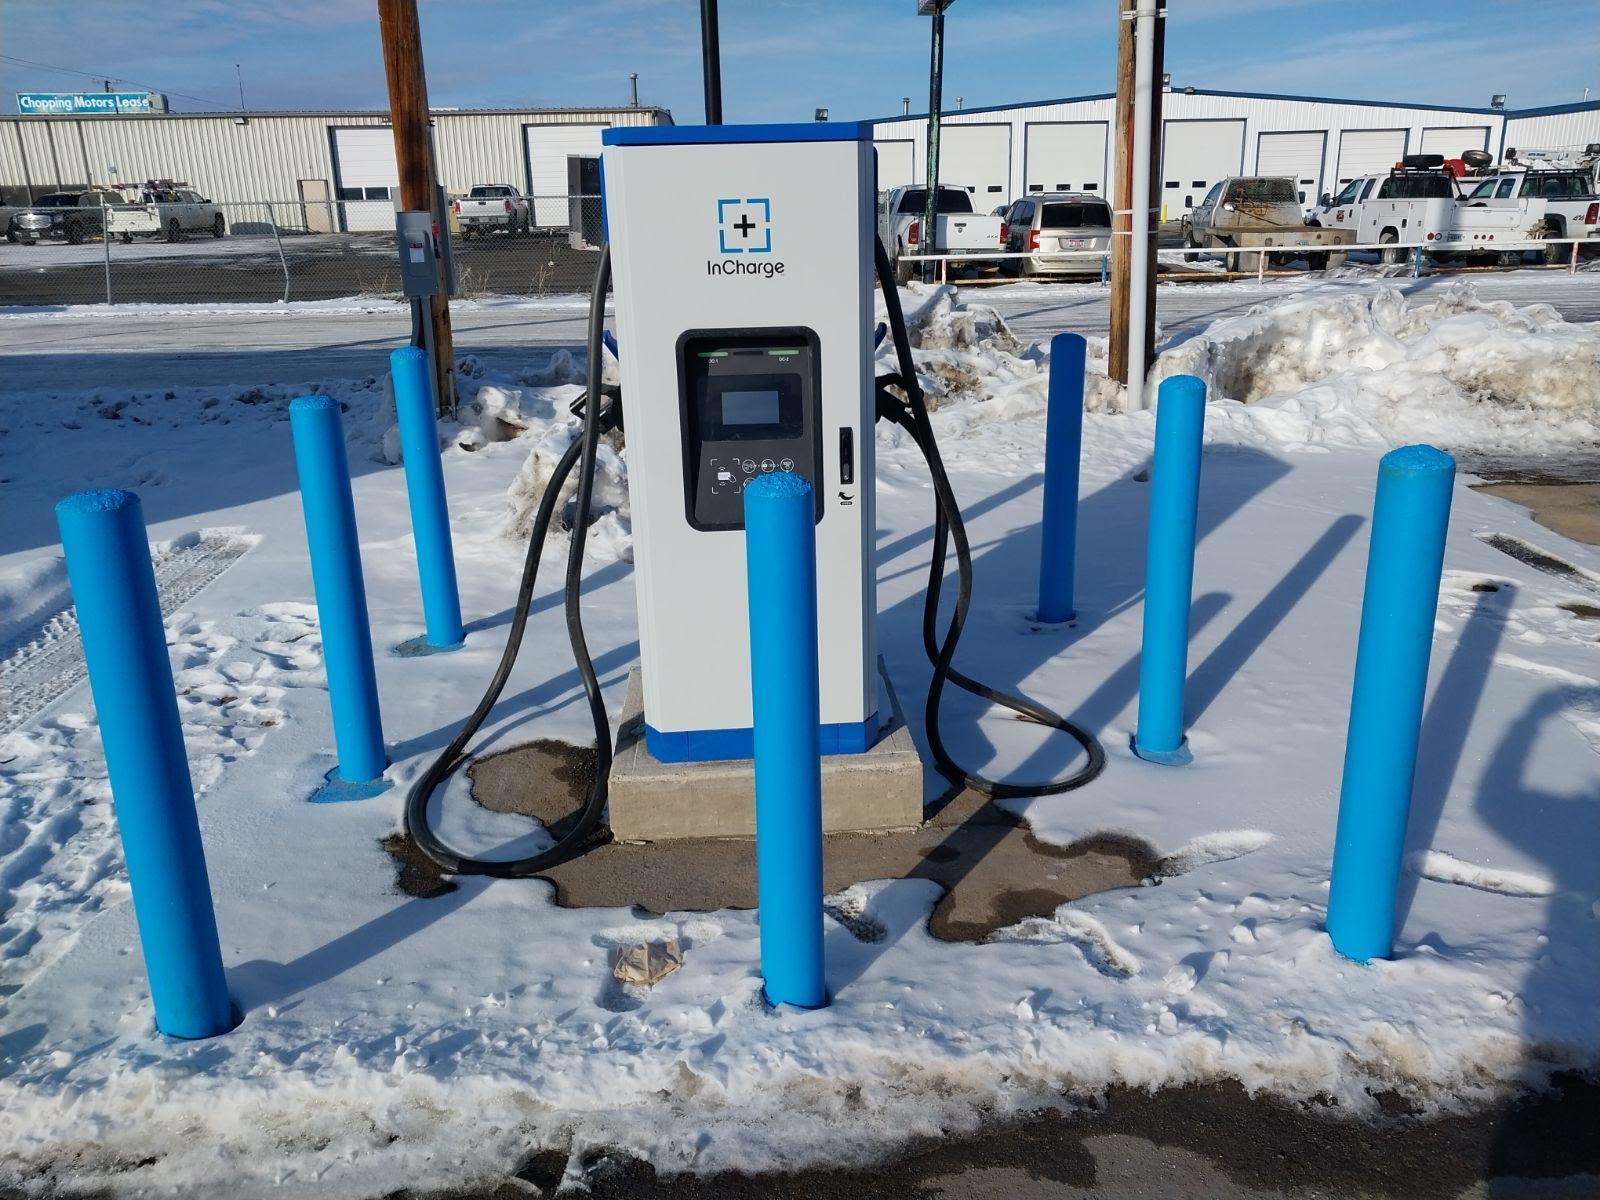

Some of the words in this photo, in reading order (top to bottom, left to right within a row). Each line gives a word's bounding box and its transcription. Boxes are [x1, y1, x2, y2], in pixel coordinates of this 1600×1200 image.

[20, 96, 72, 111] Chopping
[74, 95, 114, 108] Motors
[116, 95, 149, 107] Lease
[707, 260, 785, 278] InCharge
